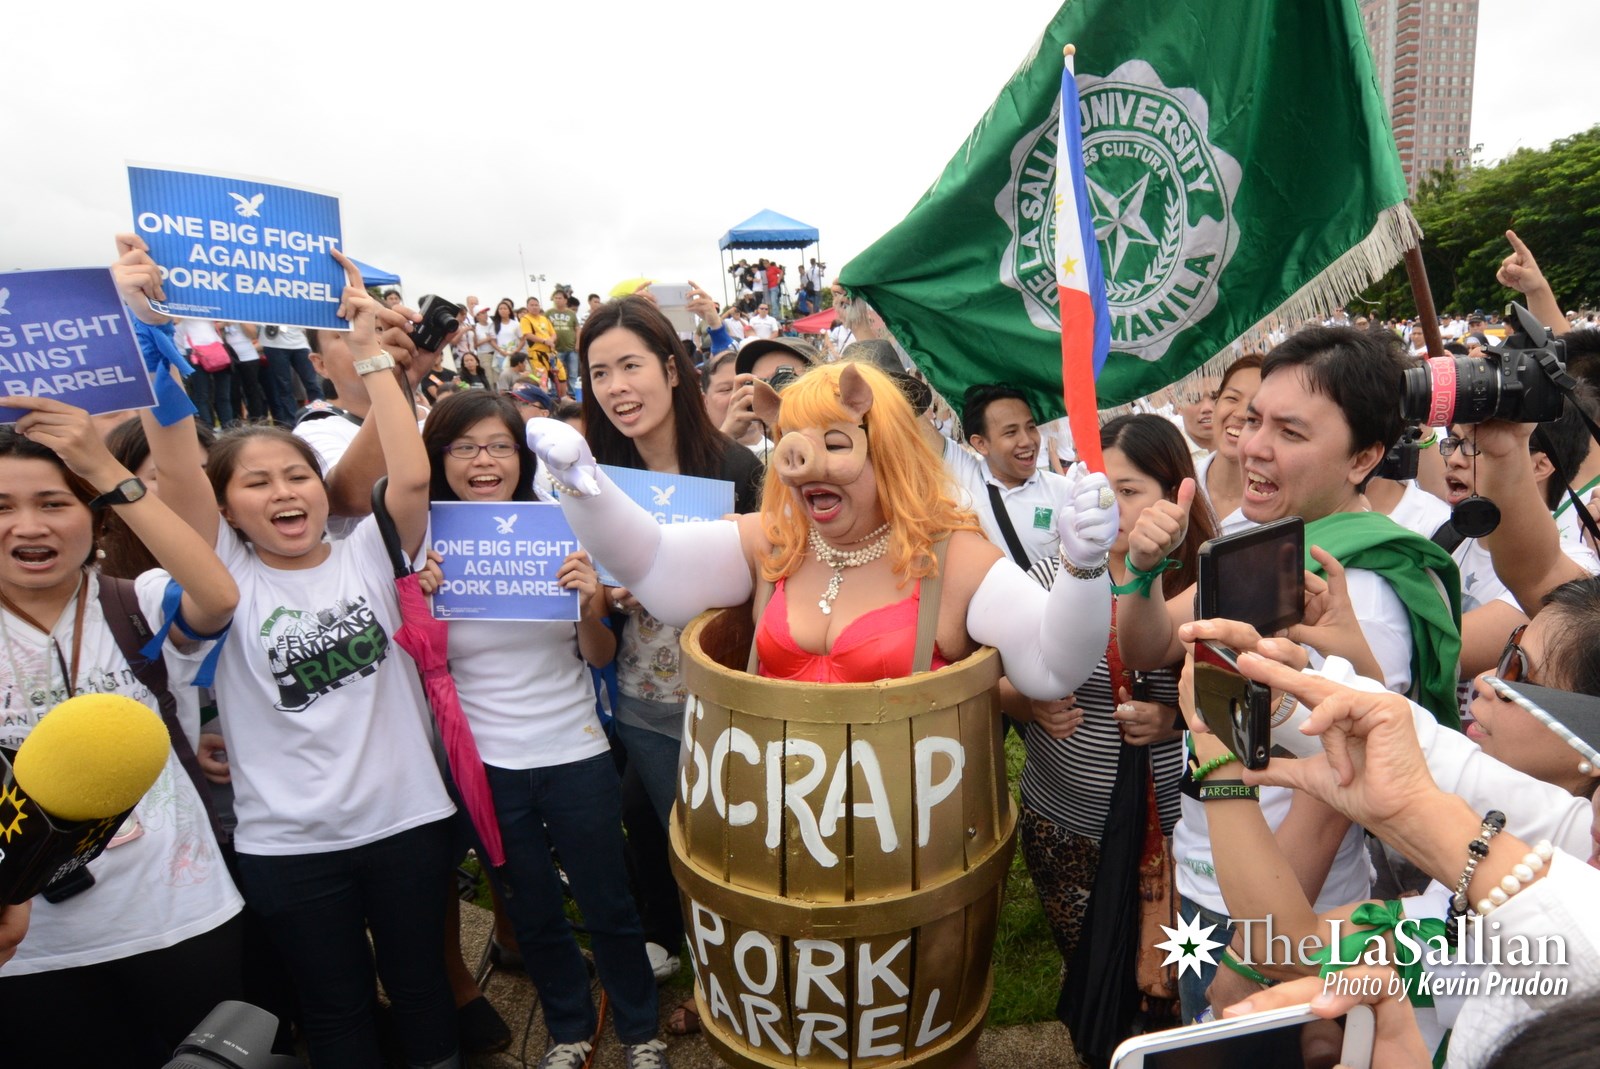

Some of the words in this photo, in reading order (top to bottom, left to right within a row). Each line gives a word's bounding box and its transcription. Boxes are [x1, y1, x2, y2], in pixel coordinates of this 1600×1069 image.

[1101, 142, 1168, 181] CULTURA
[138, 212, 204, 239] ONE
[209, 219, 258, 245] BIG
[264, 227, 339, 254] FIGHT
[1020, 226, 1042, 270] LA
[189, 244, 310, 276] AGAINST
[158, 265, 230, 292] PORK
[235, 273, 340, 303] BARREL
[1110, 253, 1216, 341] MANILA
[20, 314, 121, 345] FIGHT
[4, 366, 136, 398] BARREL
[434, 540, 474, 556] ONE
[478, 540, 511, 556] BIG
[515, 541, 574, 557] FIGHT
[464, 560, 548, 576] AGAINST
[439, 580, 493, 596] PORK
[495, 580, 571, 597] BARREL
[286, 607, 375, 666] AMAZING
[294, 624, 384, 690] RACE
[681, 694, 965, 867] SCRAP
[1207, 787, 1251, 797] ARCHER
[691, 899, 911, 1010] PORK
